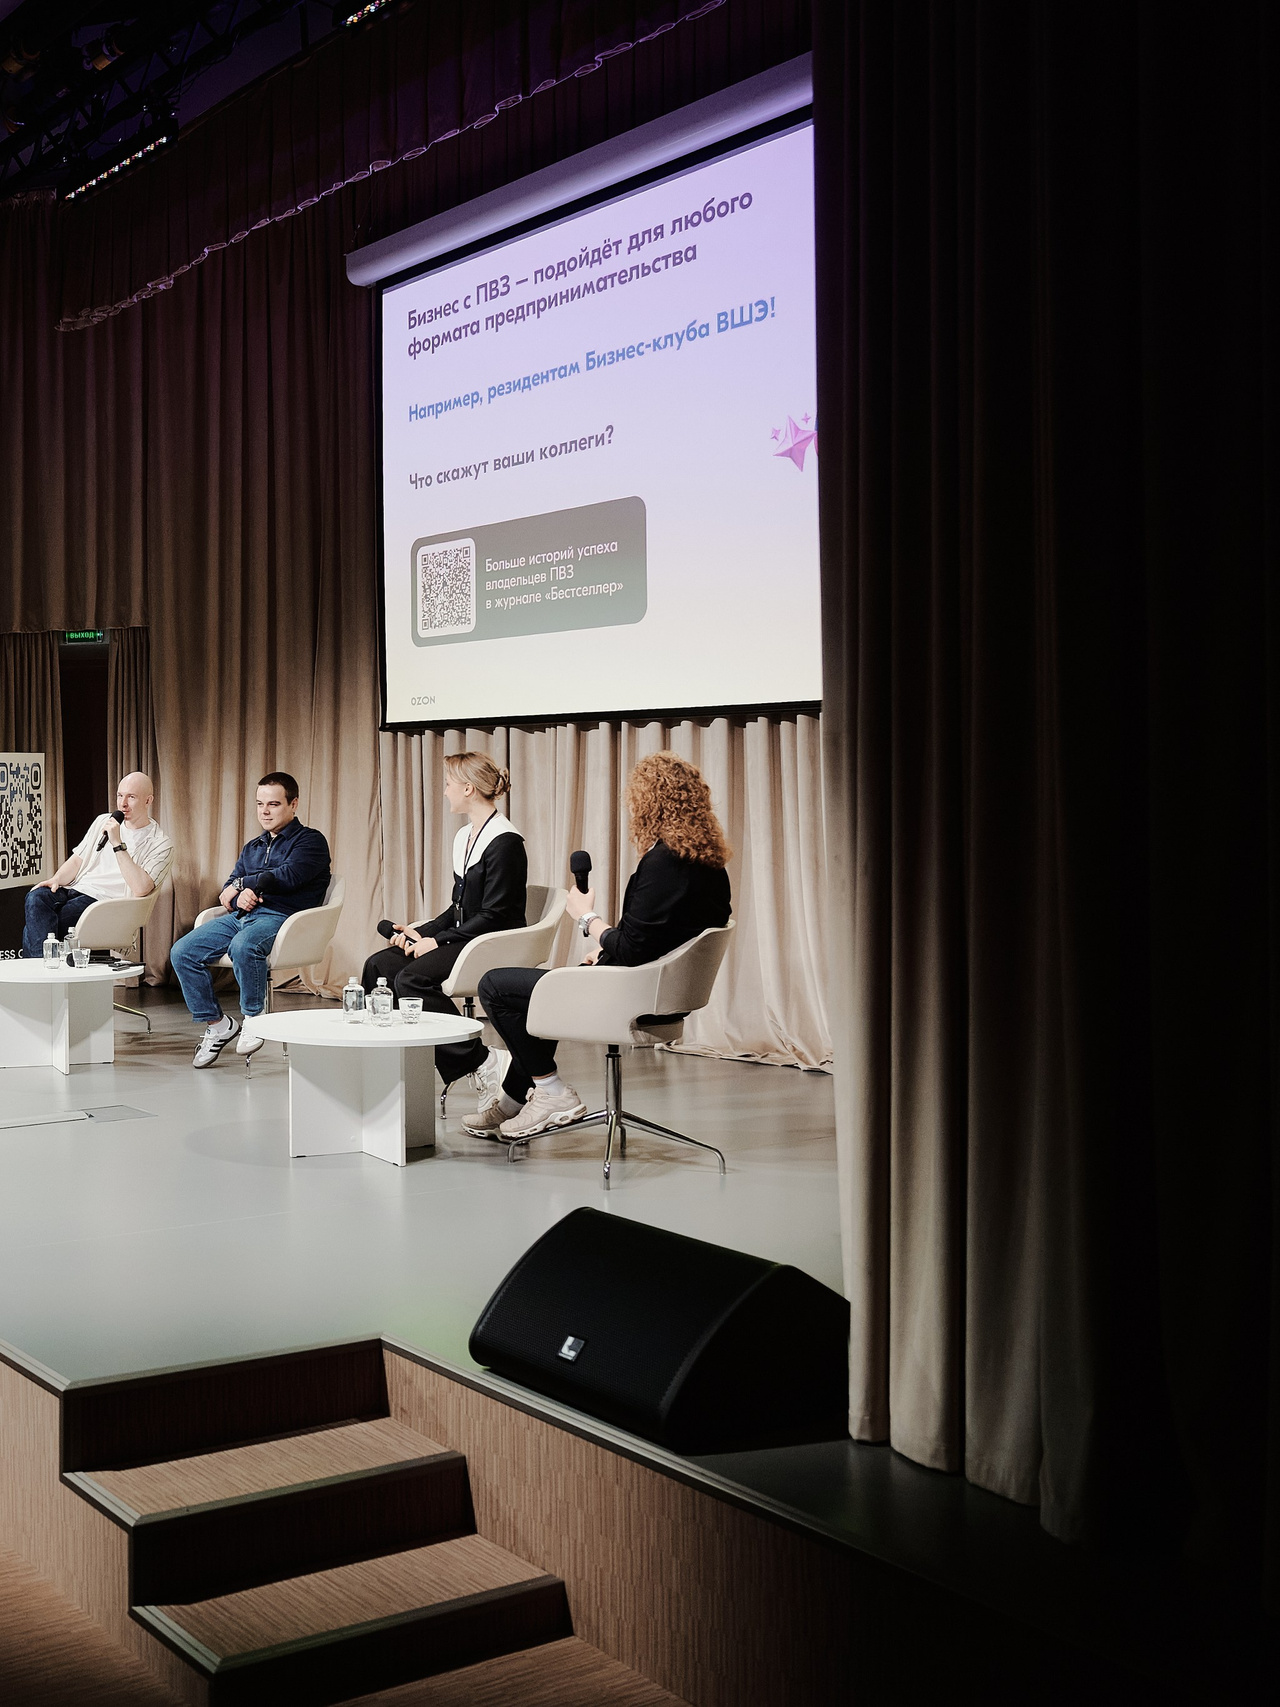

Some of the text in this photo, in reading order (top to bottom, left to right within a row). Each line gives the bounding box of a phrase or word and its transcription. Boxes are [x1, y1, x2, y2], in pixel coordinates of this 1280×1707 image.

[407, 298, 460, 330] Бизнес
[463, 293, 472, 309] с
[475, 274, 511, 307] ПВЗ
[533, 237, 623, 285] подойдёт
[627, 223, 665, 255] для
[670, 191, 754, 236] любого
[407, 244, 698, 360] формата предпринимательства
[408, 296, 777, 423] Например, резидентам Бизнес-клуба ВШЭ!
[409, 424, 615, 491] Что скажут ваши коллеги?
[485, 539, 618, 573] Больше историй успеха
[485, 565, 574, 592] владельцев ПВЗ
[485, 579, 624, 611] в журнале «Бестселлер»
[70, 631, 95, 639] ВЫХОД
[411, 696, 436, 707] OZON
